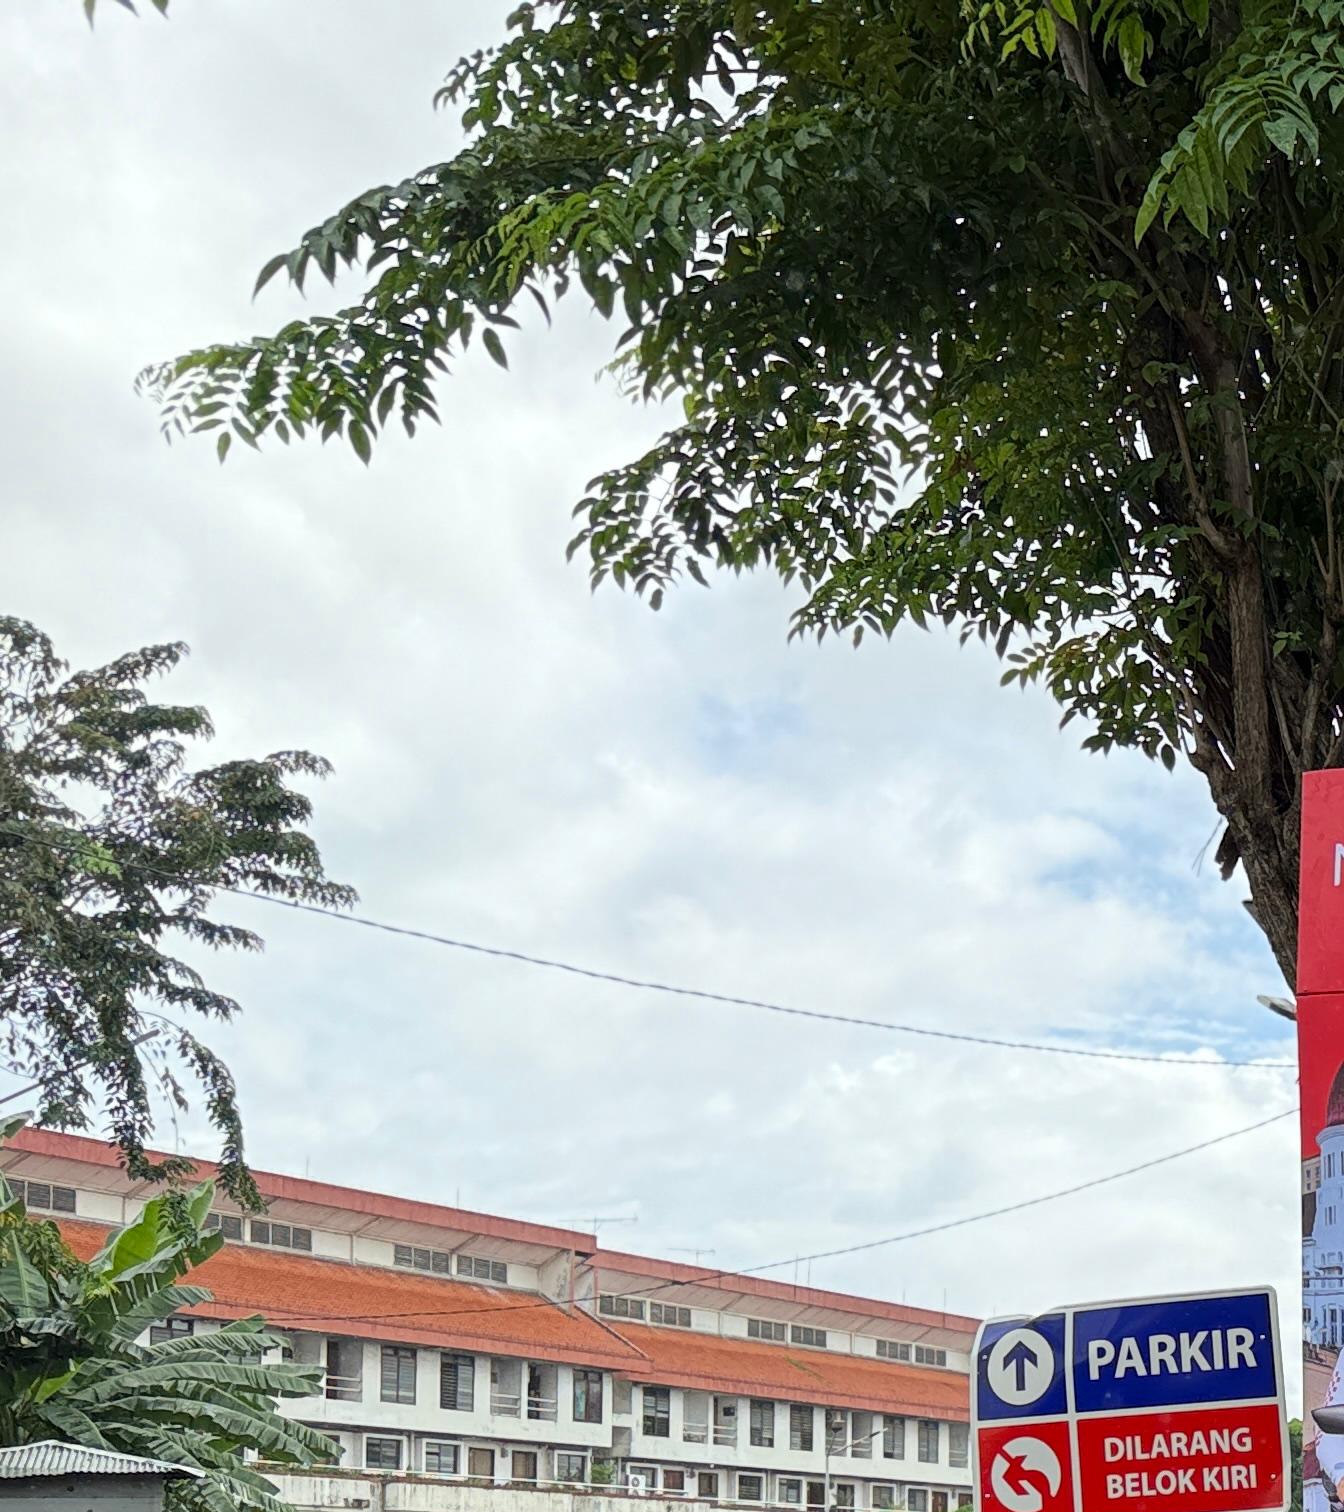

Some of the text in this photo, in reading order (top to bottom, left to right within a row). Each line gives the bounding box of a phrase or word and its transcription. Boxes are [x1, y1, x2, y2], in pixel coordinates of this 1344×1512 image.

[1087, 1327, 1258, 1381] PARKIR
[1104, 1427, 1252, 1463] DILARANG
[1106, 1464, 1258, 1499] BELOK KIRI
